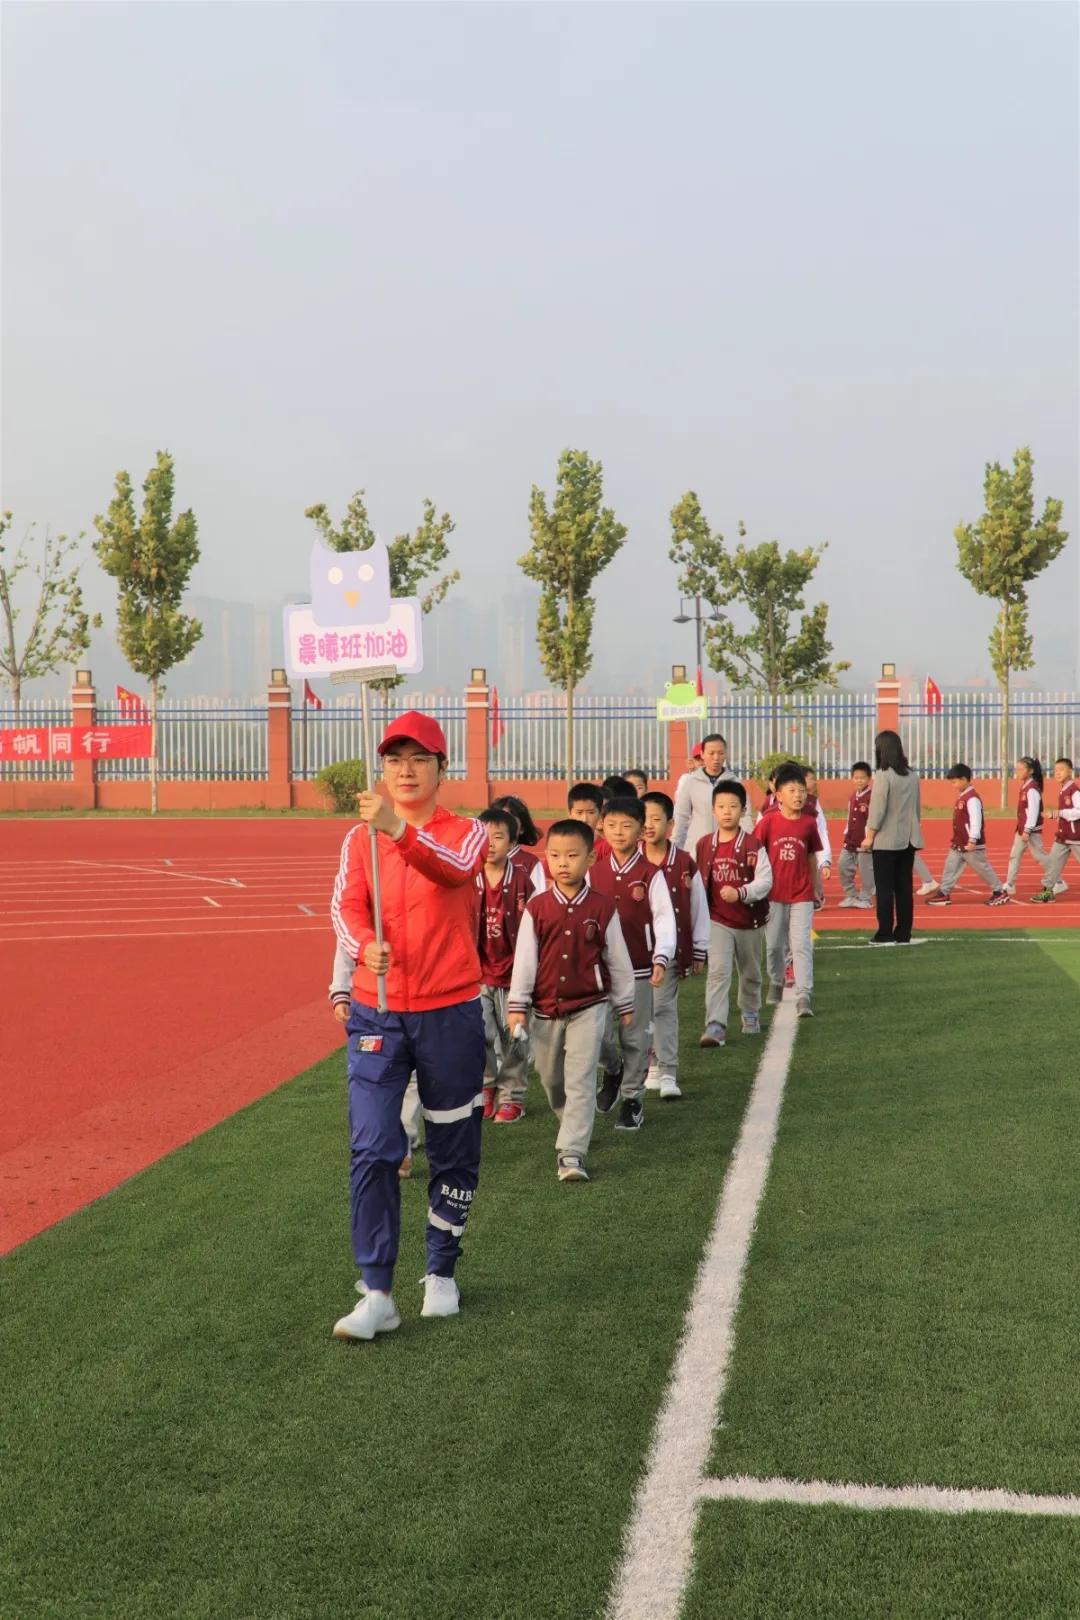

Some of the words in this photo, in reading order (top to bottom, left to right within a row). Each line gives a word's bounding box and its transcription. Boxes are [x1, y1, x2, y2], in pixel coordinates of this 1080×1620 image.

[0, 731, 111, 755] 帆同行
[780, 849, 796, 861] RS
[712, 869, 741, 882] ROYAL
[441, 1183, 476, 1202] BAIR
